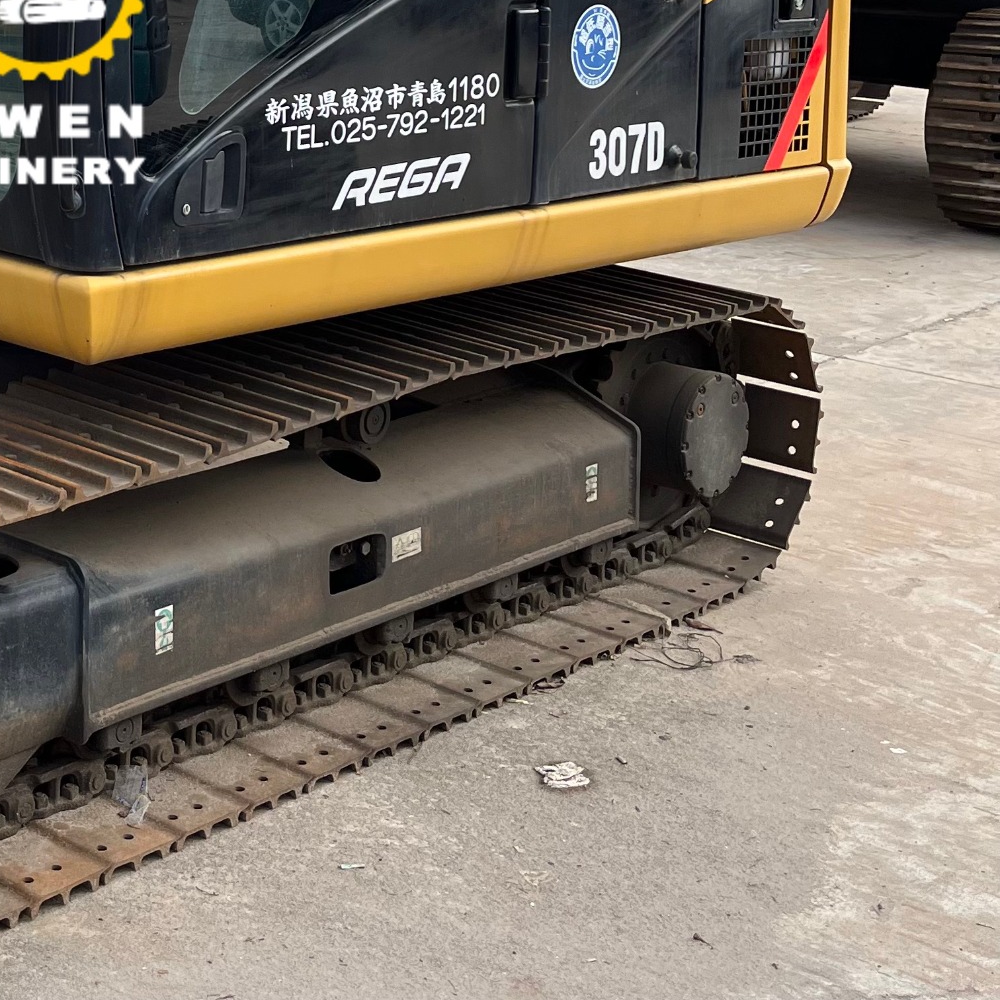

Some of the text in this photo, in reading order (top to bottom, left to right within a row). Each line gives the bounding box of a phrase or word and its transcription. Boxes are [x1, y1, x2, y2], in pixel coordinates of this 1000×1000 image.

[281, 103, 486, 152] TEL.025-792-1221
[588, 121, 665, 180] 307D
[332, 152, 471, 211] REGA
